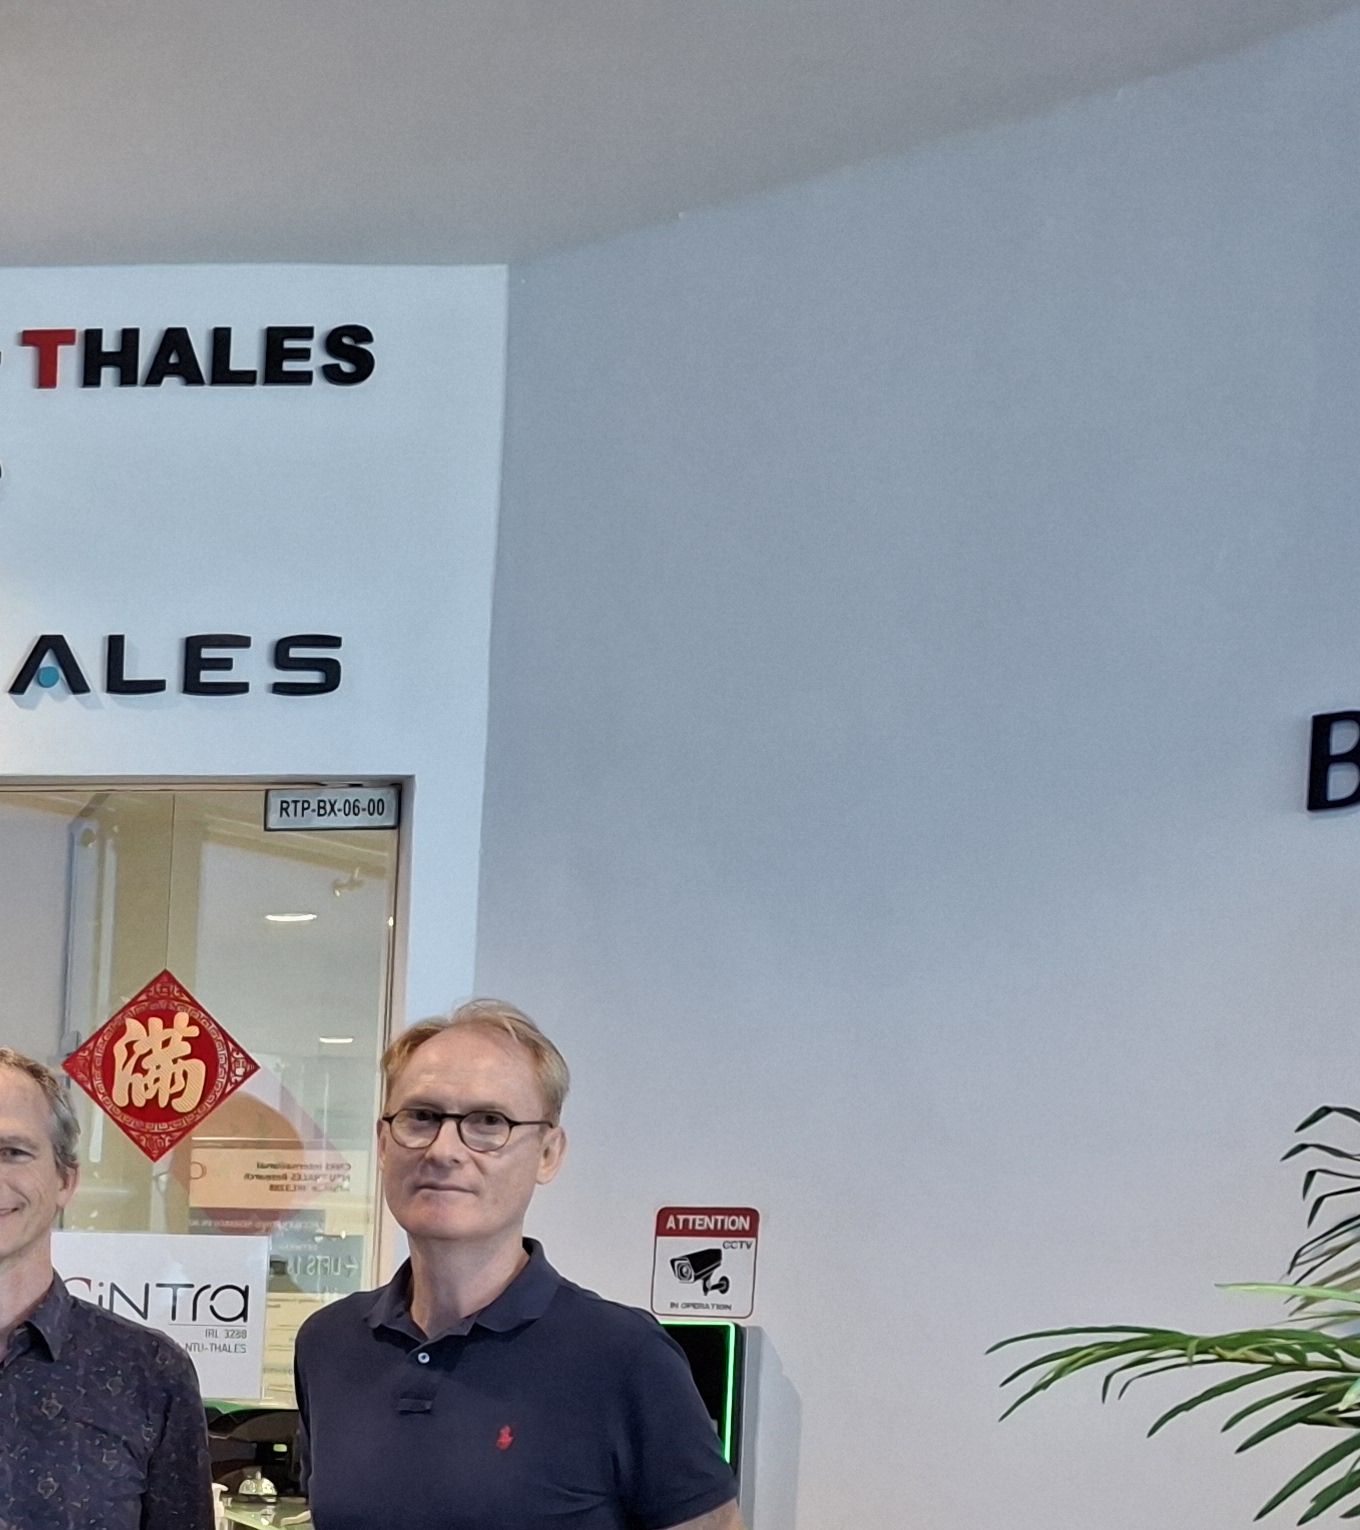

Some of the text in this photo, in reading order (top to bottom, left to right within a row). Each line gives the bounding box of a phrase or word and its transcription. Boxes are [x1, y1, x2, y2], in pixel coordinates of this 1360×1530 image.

[21, 324, 376, 389] THALES
[280, 798, 385, 818] RTP-BX-06-00
[666, 1214, 751, 1231] ATTENTION
[722, 1240, 753, 1250] CCTV
[670, 1301, 732, 1311] IN OPERATION
